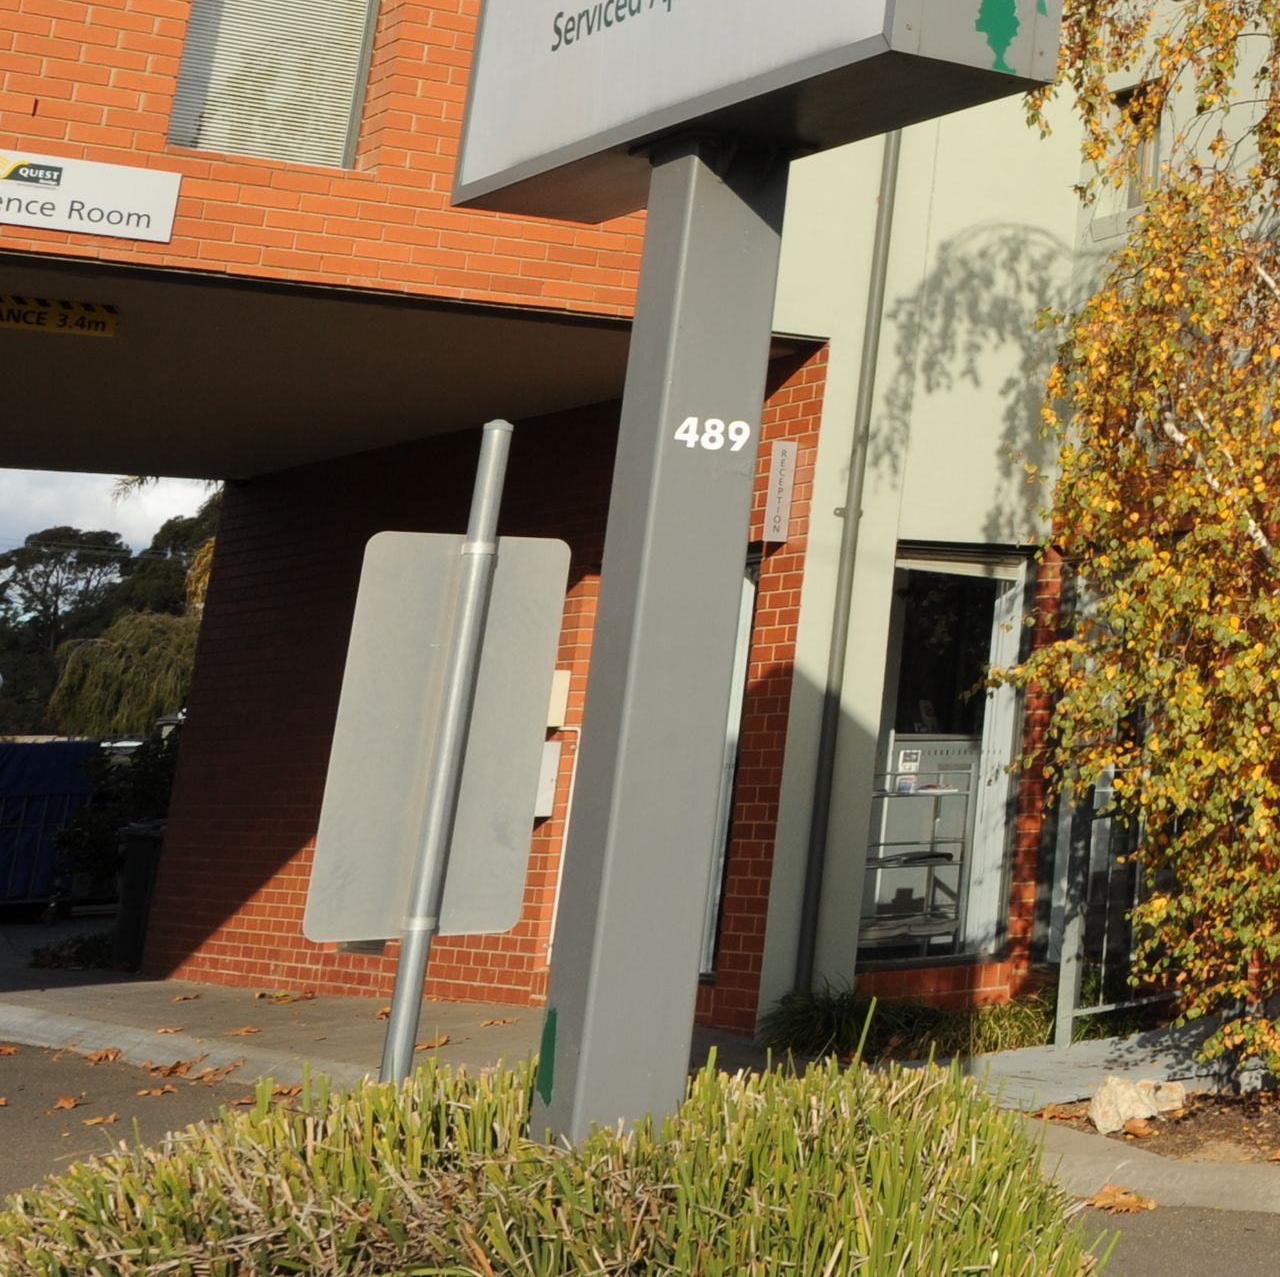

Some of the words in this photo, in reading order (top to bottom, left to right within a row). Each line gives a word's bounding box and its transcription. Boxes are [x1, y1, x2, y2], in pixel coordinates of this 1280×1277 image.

[19, 167, 60, 180] QUEST
[0, 195, 56, 218] nce
[67, 199, 151, 229] Room
[56, 313, 107, 332] 3.4m
[674, 416, 751, 452] 489
[772, 449, 788, 534] RECEPTION
